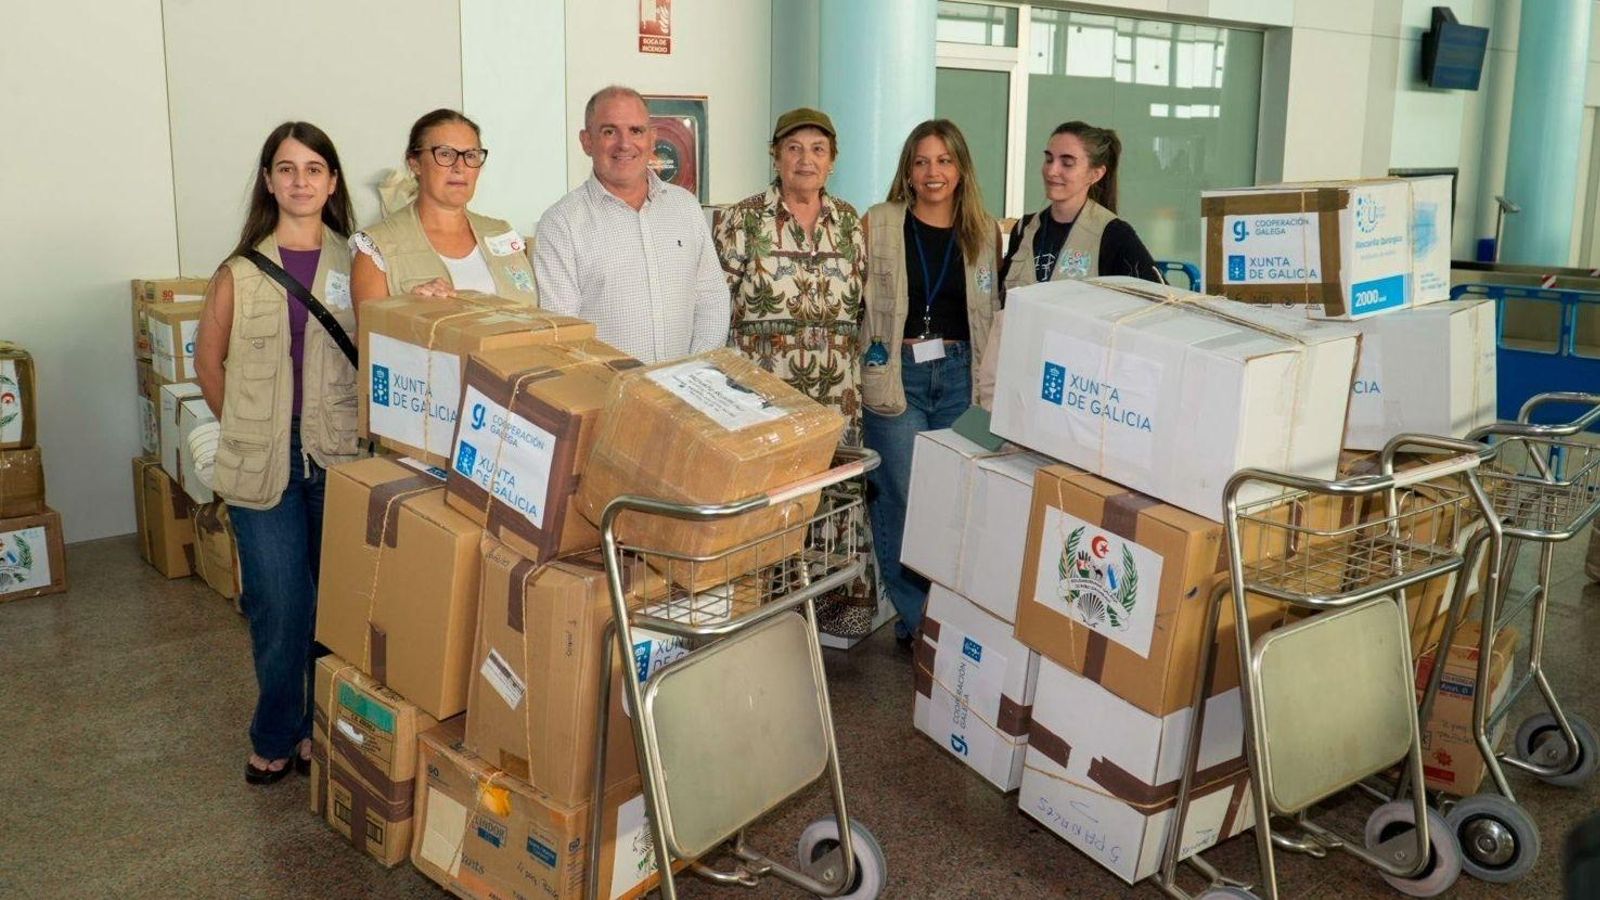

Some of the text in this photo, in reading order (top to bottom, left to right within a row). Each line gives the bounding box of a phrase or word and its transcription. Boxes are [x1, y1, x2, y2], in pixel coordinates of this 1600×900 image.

[641, 45, 668, 53] INCENDIO
[1255, 227, 1286, 235] GALEGA
[1249, 257, 1290, 267] XUNTA
[1249, 268, 1318, 279] DE GALICIA
[1355, 289, 1379, 307] 2000
[393, 373, 433, 397] XUNTA
[1070, 373, 1120, 403] XUNTA
[393, 391, 458, 423] DE GALICIA
[1067, 391, 1152, 432] DE GALICIA
[478, 456, 516, 489] XUTA
[492, 480, 538, 518] GALICIA
